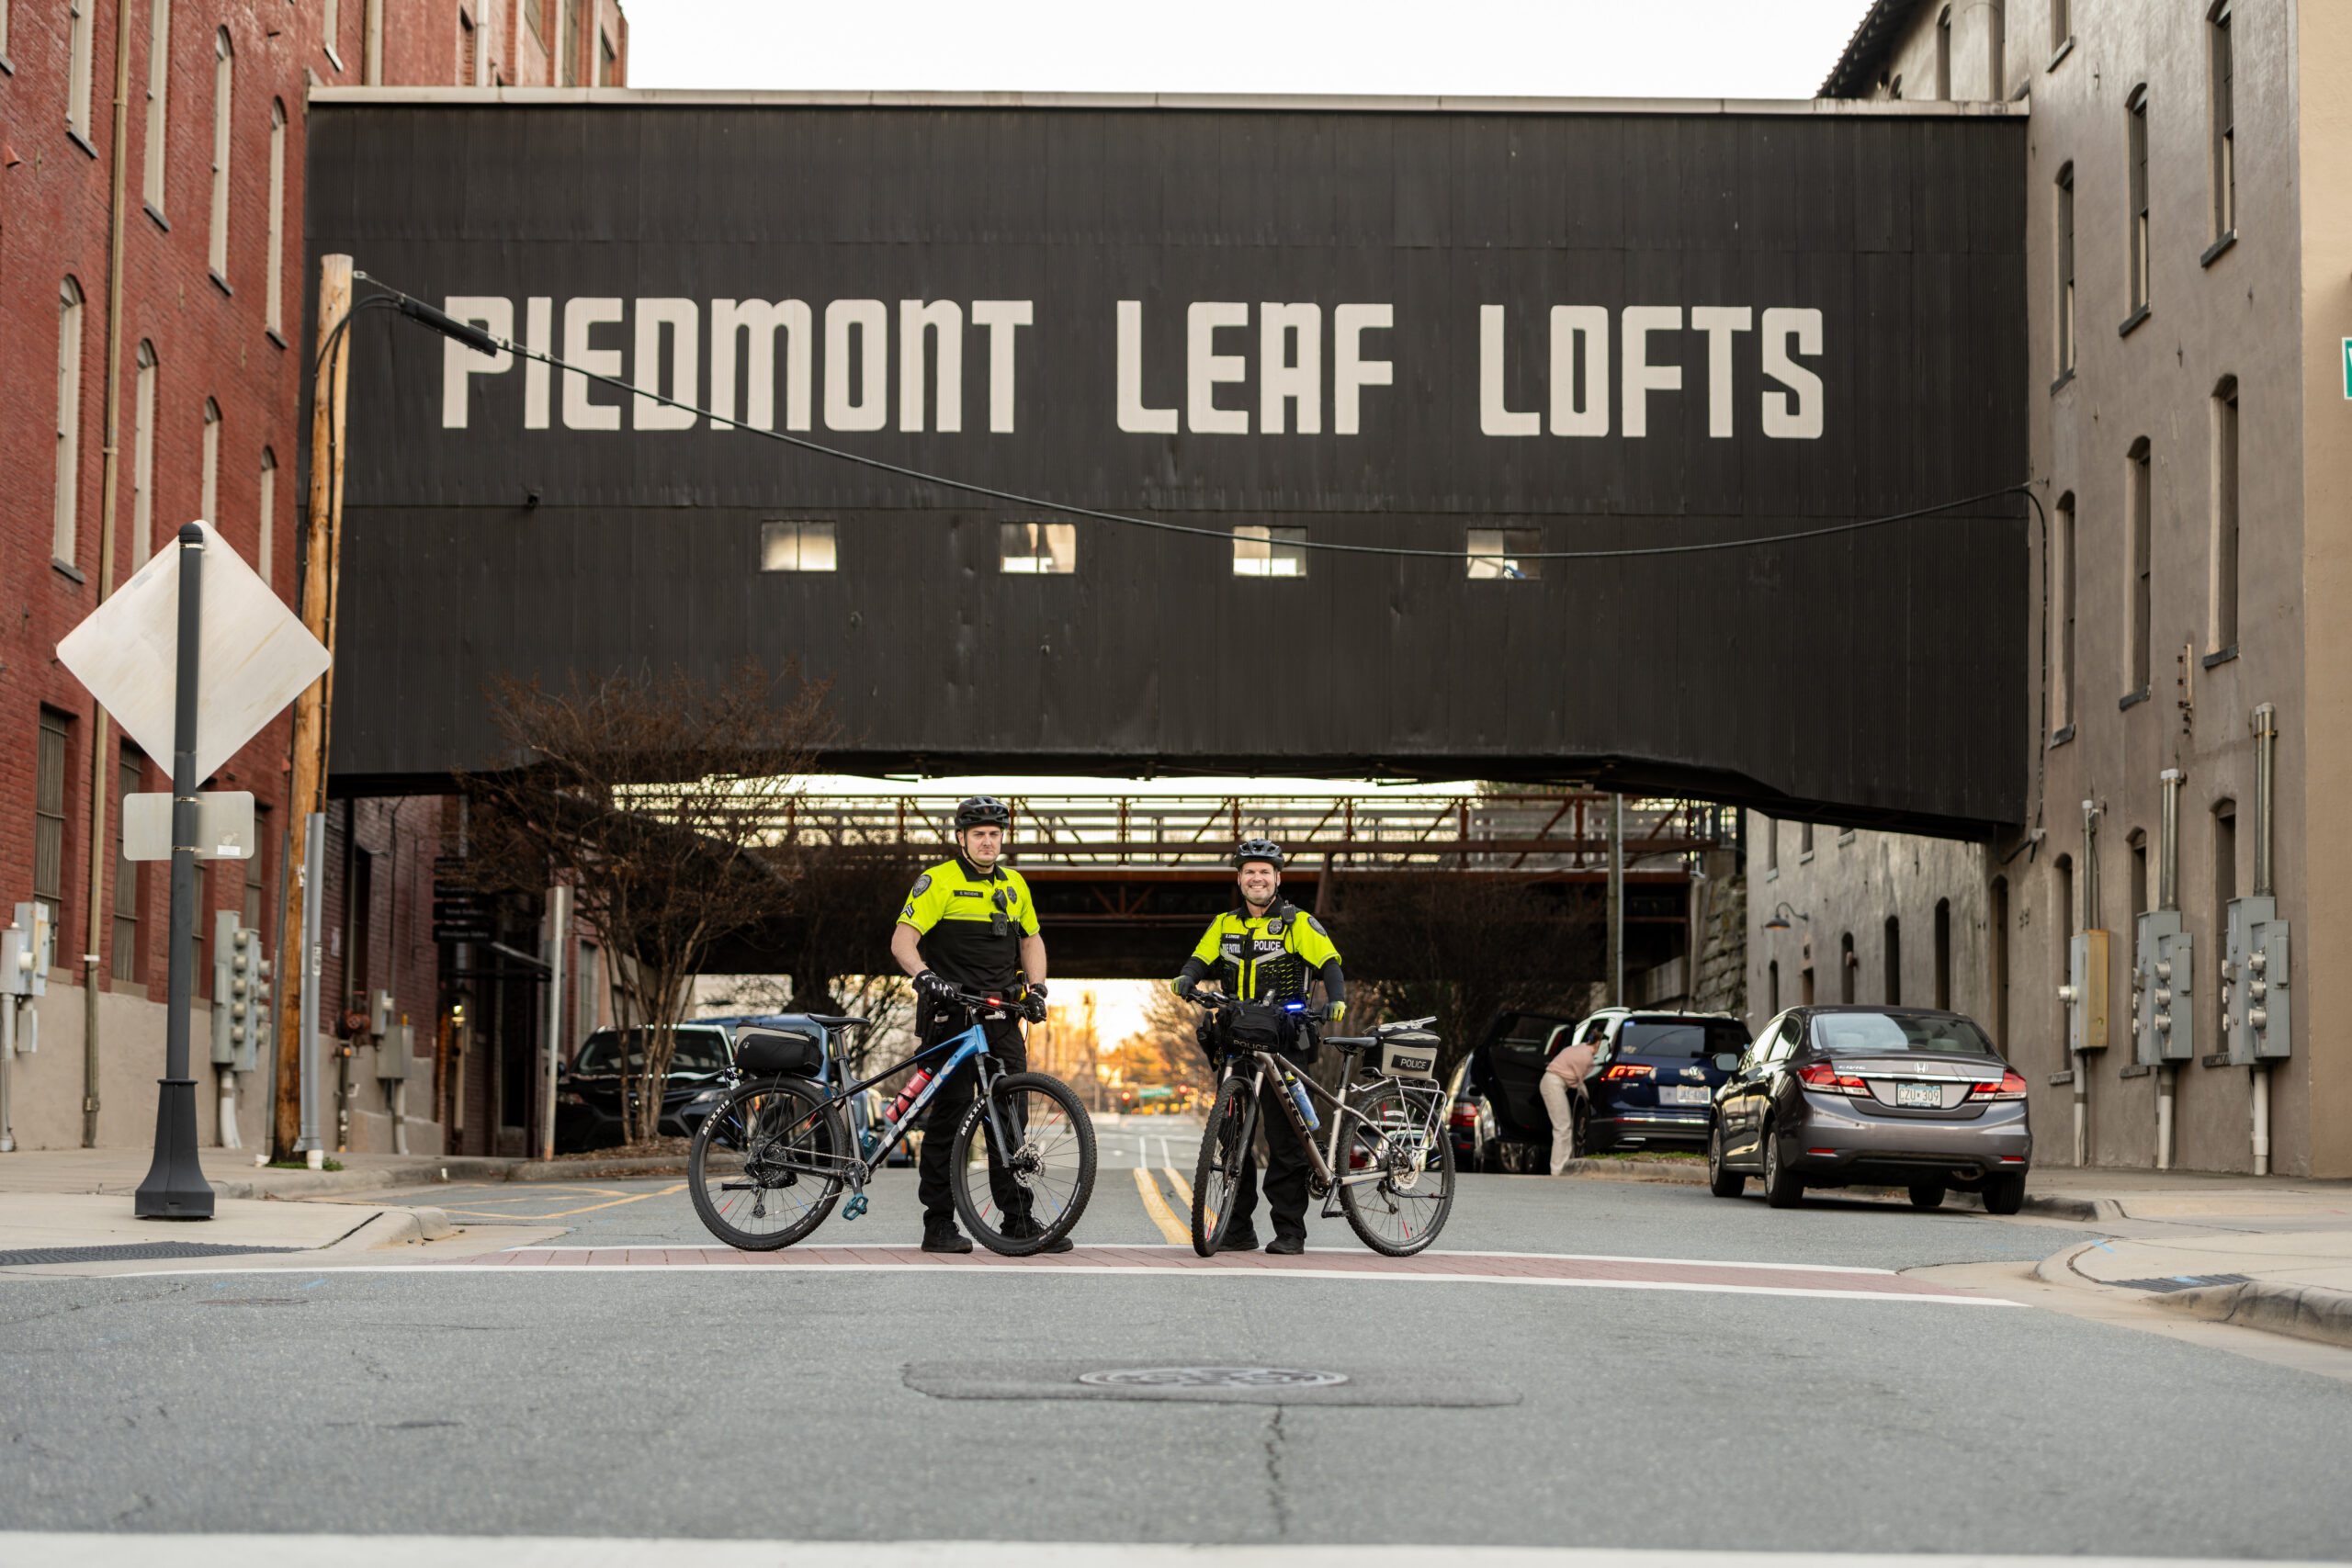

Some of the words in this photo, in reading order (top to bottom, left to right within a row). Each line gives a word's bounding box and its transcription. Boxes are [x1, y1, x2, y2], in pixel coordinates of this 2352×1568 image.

[443, 296, 1034, 434] PIEDMONT
[1116, 300, 1394, 434] LEAF
[1480, 304, 1823, 439] LOFTS
[1253, 940, 1281, 951] POLICE
[1233, 1039, 1269, 1051] POLICE
[1400, 1058, 1427, 1069] POLICE
[1922, 1089, 1939, 1101] 309
[702, 1099, 730, 1136] MAXXIS
[866, 1056, 956, 1166] TREK
[960, 1099, 986, 1136] MAXXIS
